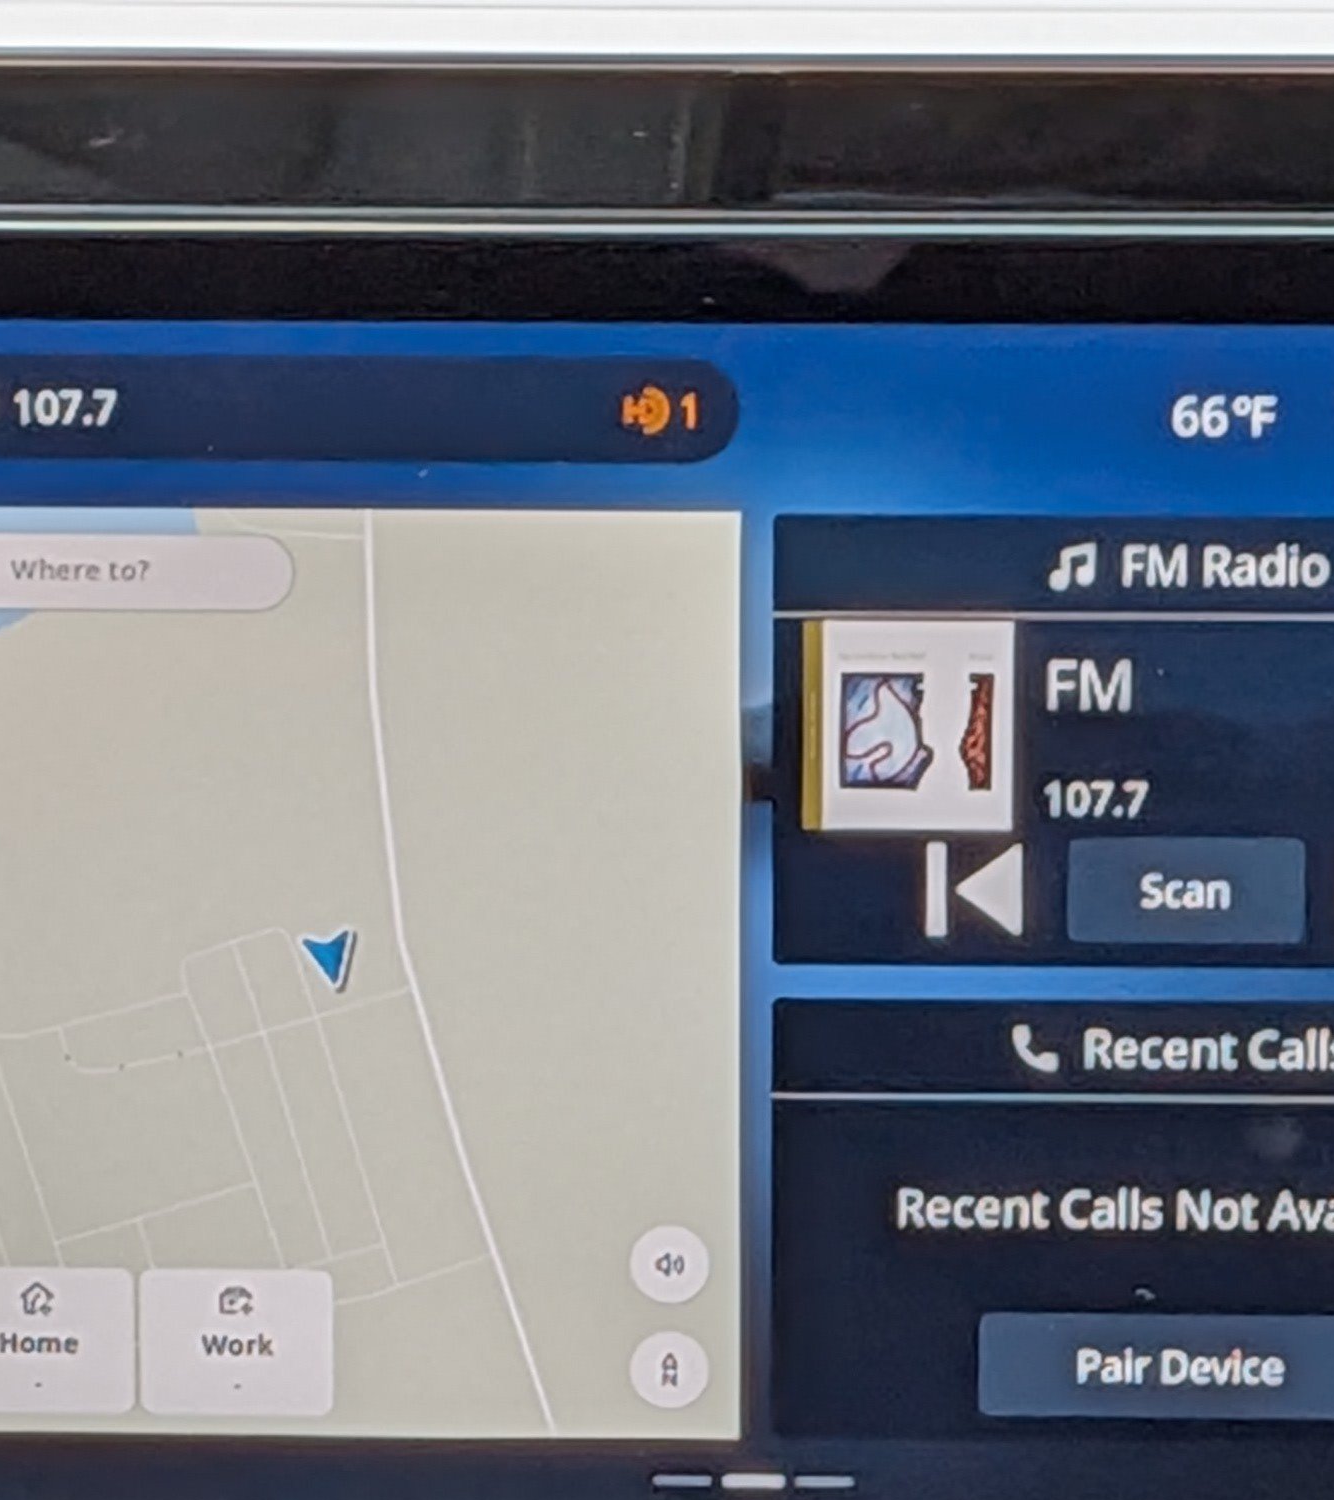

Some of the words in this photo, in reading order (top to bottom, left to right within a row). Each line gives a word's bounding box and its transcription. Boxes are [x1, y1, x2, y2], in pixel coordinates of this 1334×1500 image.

[12, 387, 119, 428] 107.7
[679, 391, 698, 430] 1
[9, 557, 102, 583] Where
[107, 558, 152, 583] to?
[1120, 543, 1189, 588] FM
[1202, 541, 1332, 589] Radio
[1045, 657, 1133, 713] FM
[1043, 778, 1150, 820] 107.7
[1139, 871, 1232, 911] Scan
[1082, 1026, 1239, 1072] Recent
[896, 1187, 1051, 1231] Recent
[1058, 1186, 1165, 1232] Calls
[1175, 1188, 1259, 1232] Not
[200, 1332, 275, 1358] Work
[1075, 1346, 1153, 1386] Pair
[1159, 1347, 1286, 1387] Device
